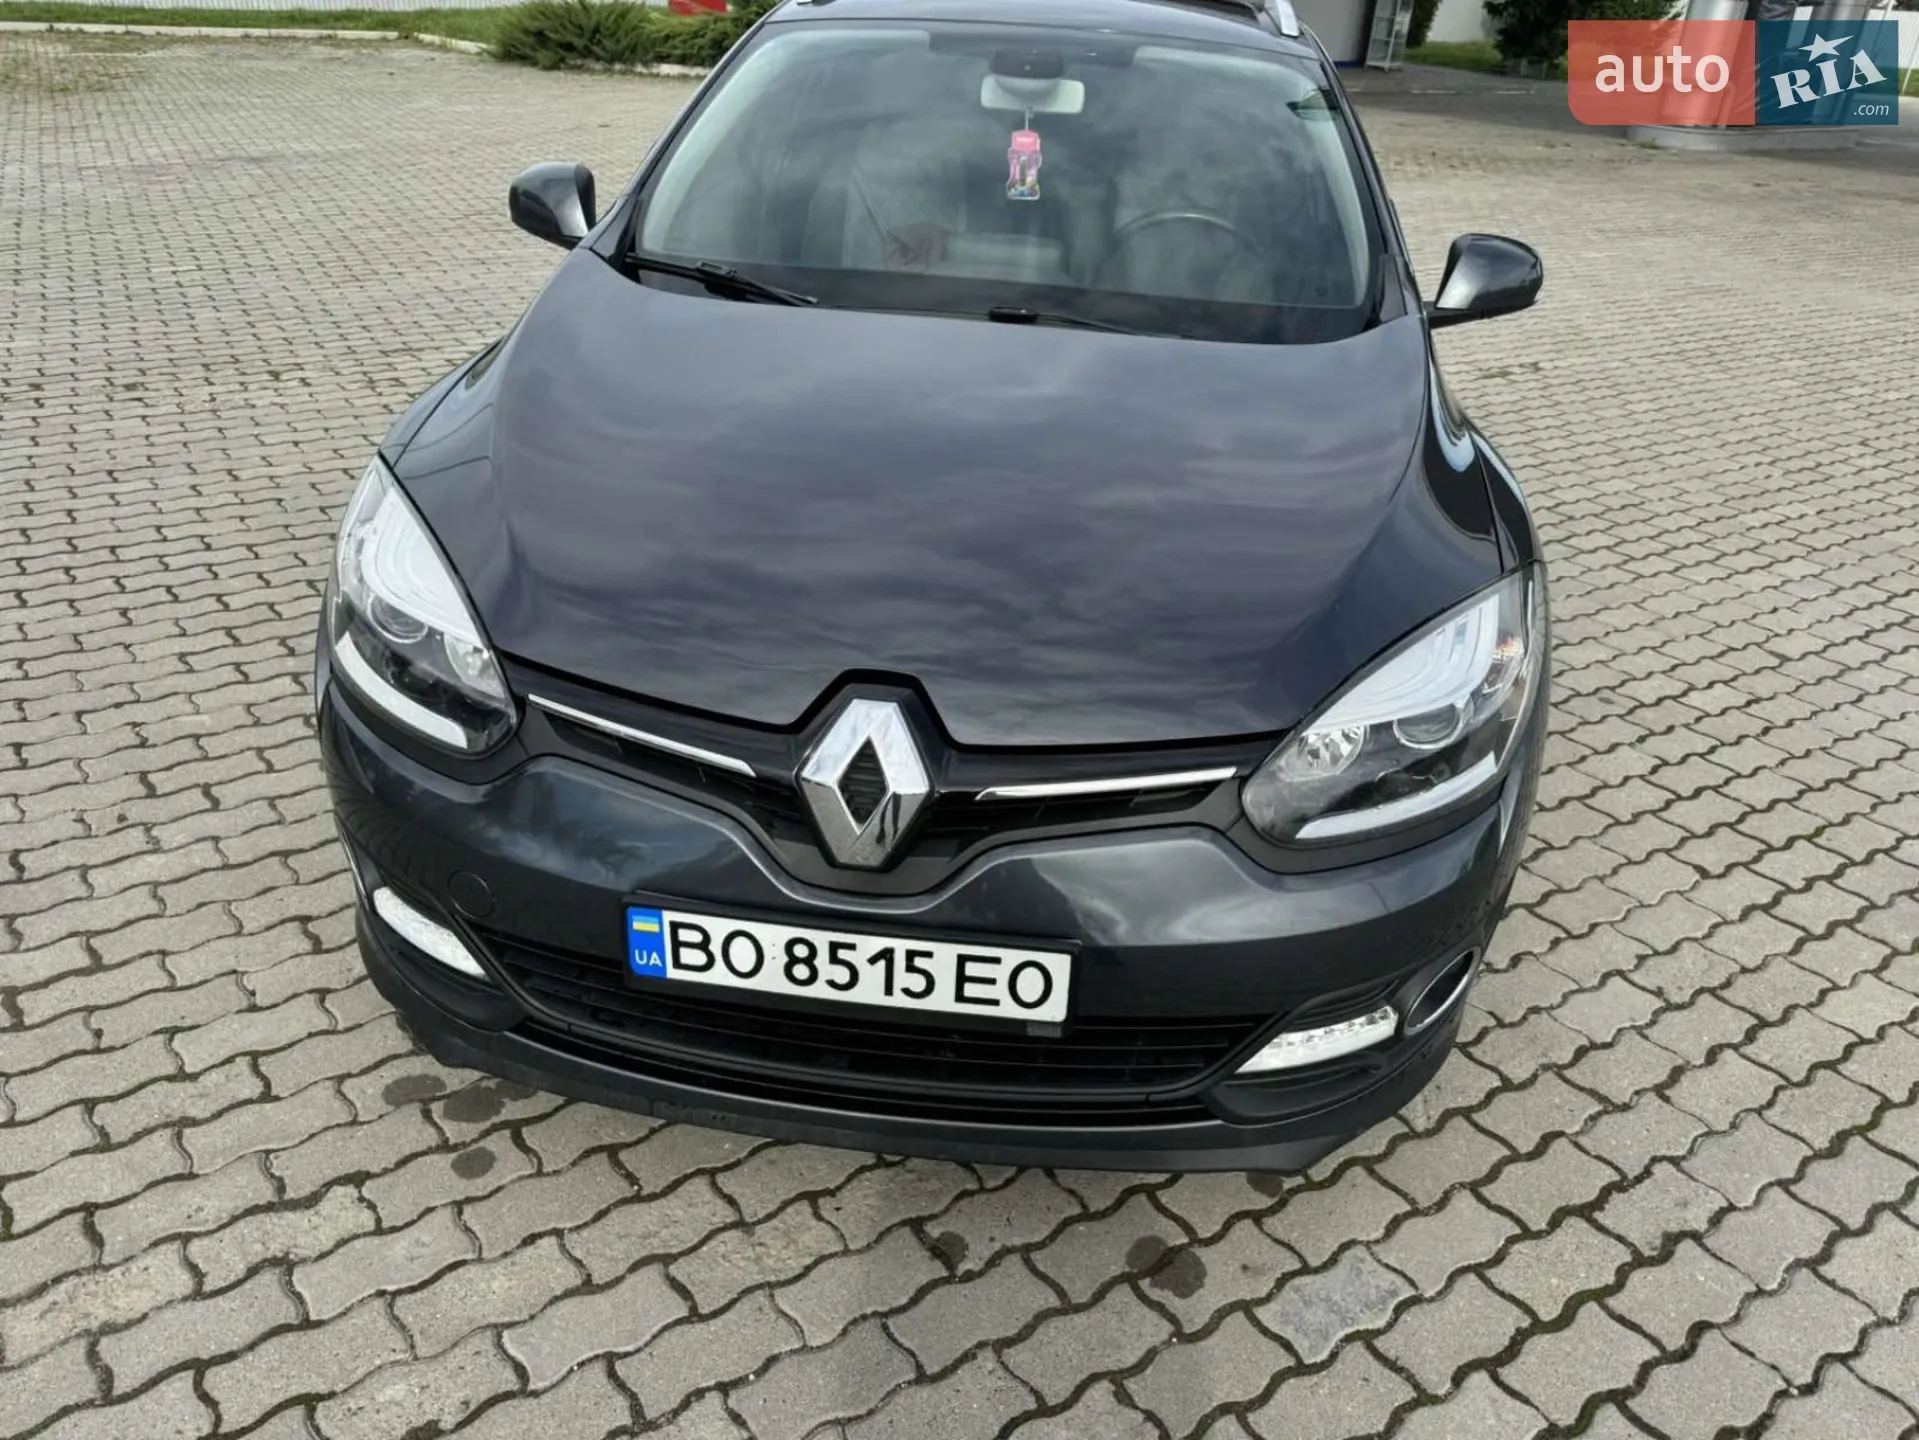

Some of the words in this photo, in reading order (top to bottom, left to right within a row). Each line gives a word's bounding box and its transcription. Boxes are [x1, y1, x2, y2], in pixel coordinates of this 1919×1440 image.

[635, 949, 663, 968] UA
[668, 920, 765, 980] BO
[783, 937, 936, 1000] 8515
[954, 953, 1053, 1010] EO
